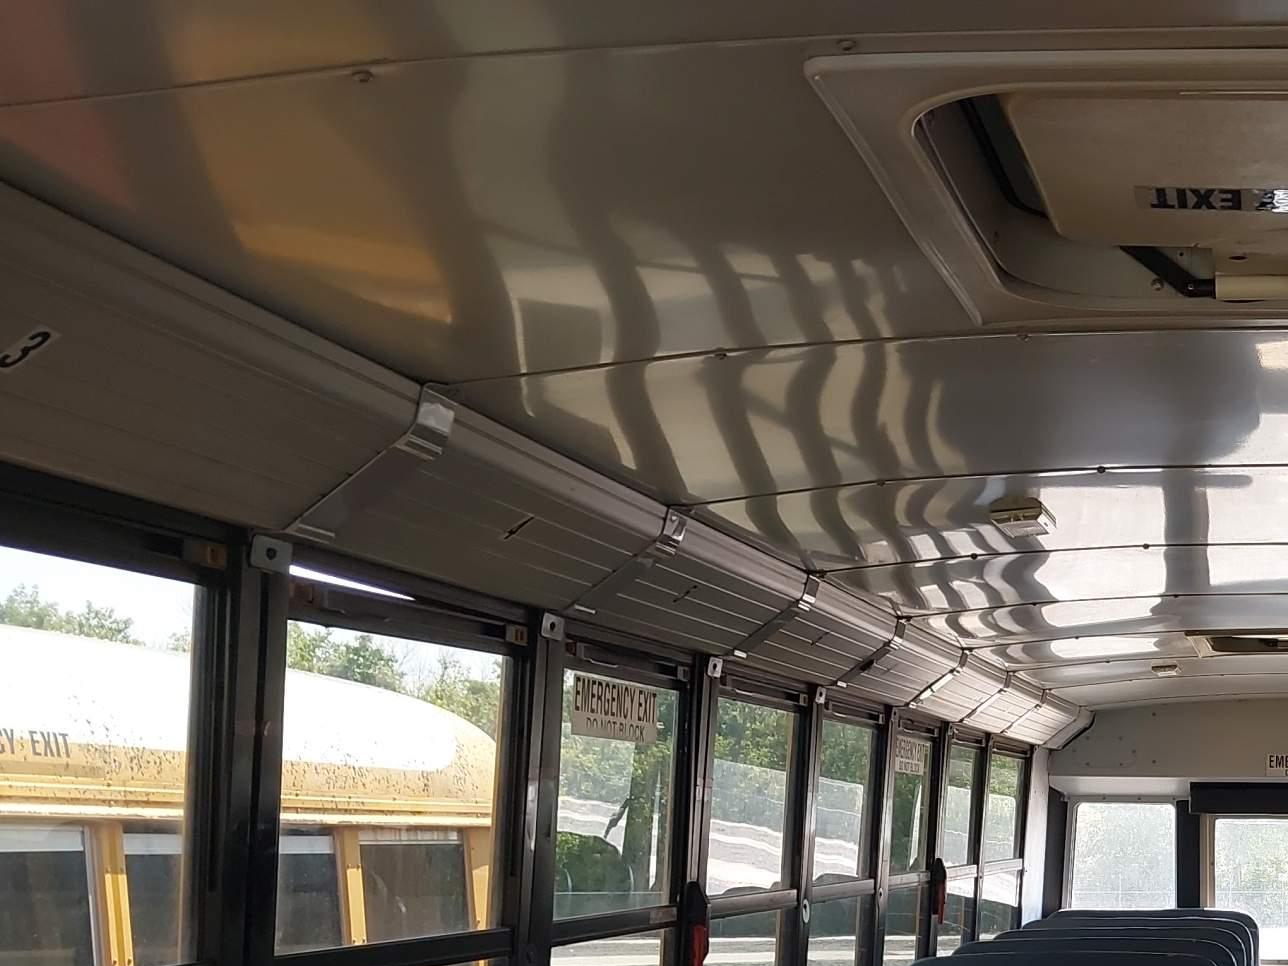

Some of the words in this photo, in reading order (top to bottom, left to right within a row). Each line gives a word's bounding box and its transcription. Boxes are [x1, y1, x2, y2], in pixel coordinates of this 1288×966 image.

[1150, 187, 1243, 211] EXIT
[575, 676, 636, 720] EMERGENCY
[637, 690, 657, 724] EXIT
[586, 717, 599, 731] DO
[619, 721, 646, 742] BLOCK
[28, 730, 71, 759] EXIT
